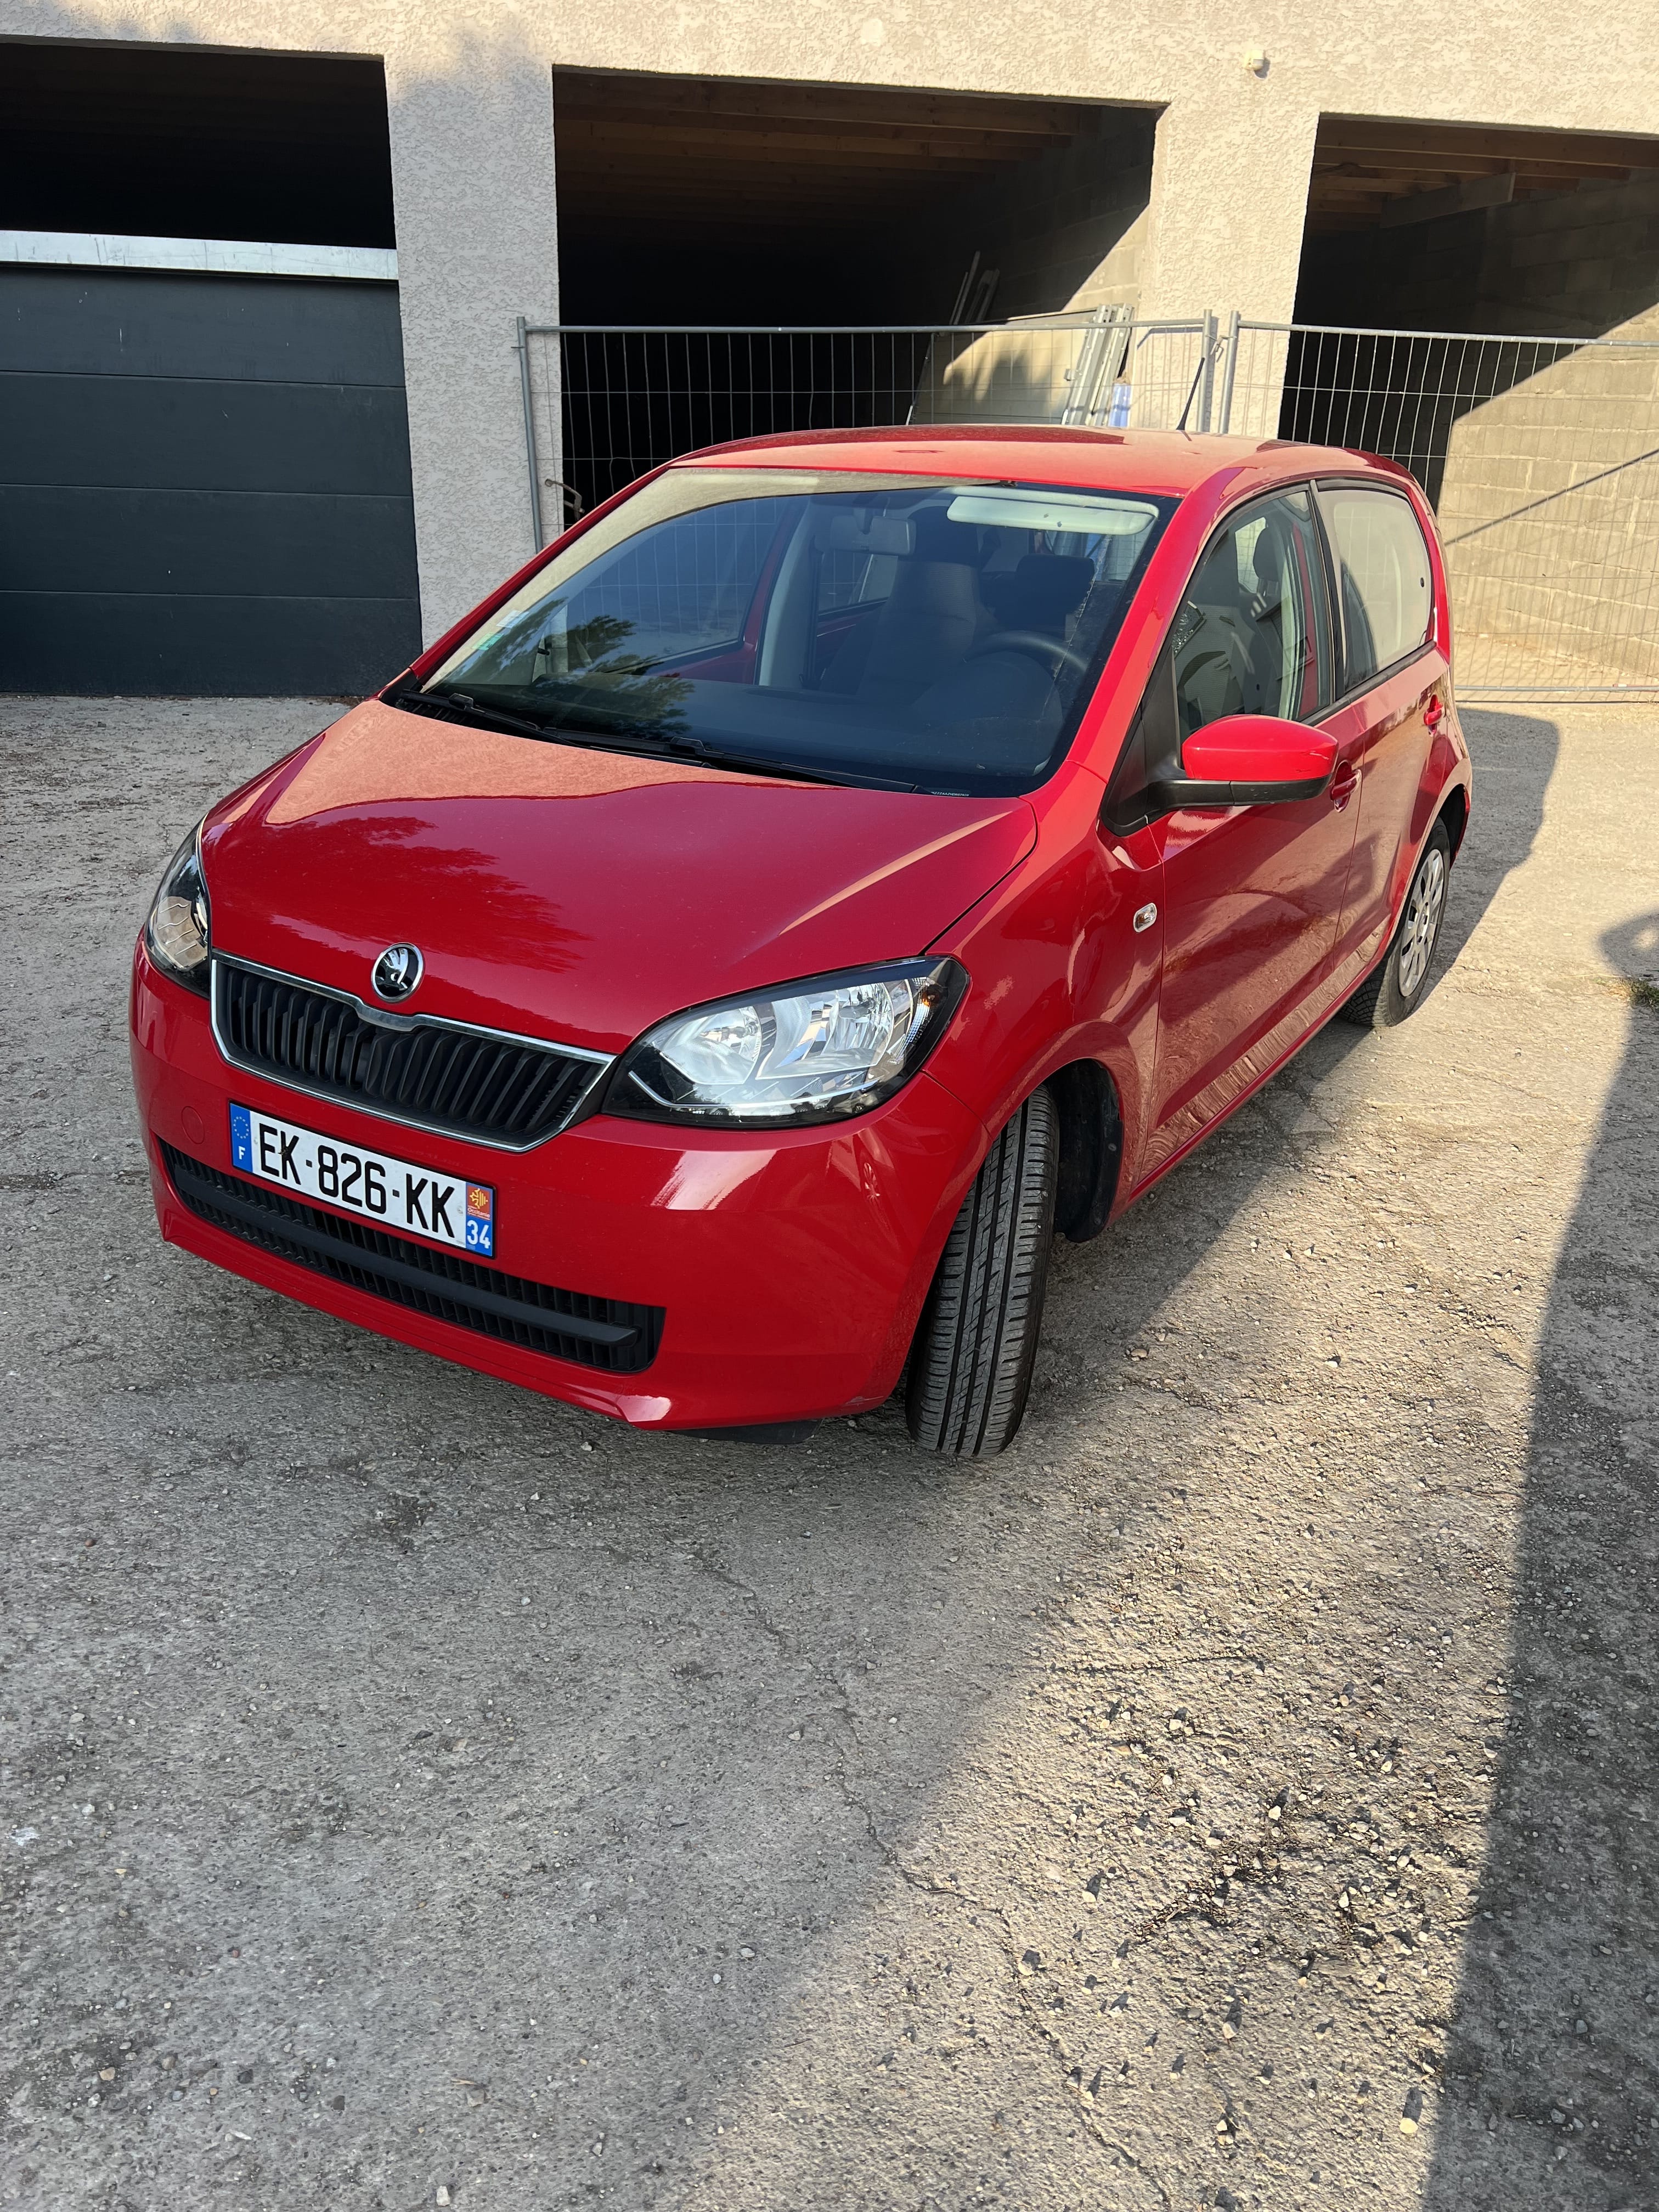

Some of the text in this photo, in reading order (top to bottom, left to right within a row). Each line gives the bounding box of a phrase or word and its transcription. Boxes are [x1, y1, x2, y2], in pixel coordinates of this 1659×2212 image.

[238, 1146, 246, 1160] F
[259, 1122, 455, 1239] EK-826-KK
[467, 1220, 491, 1249] 34
